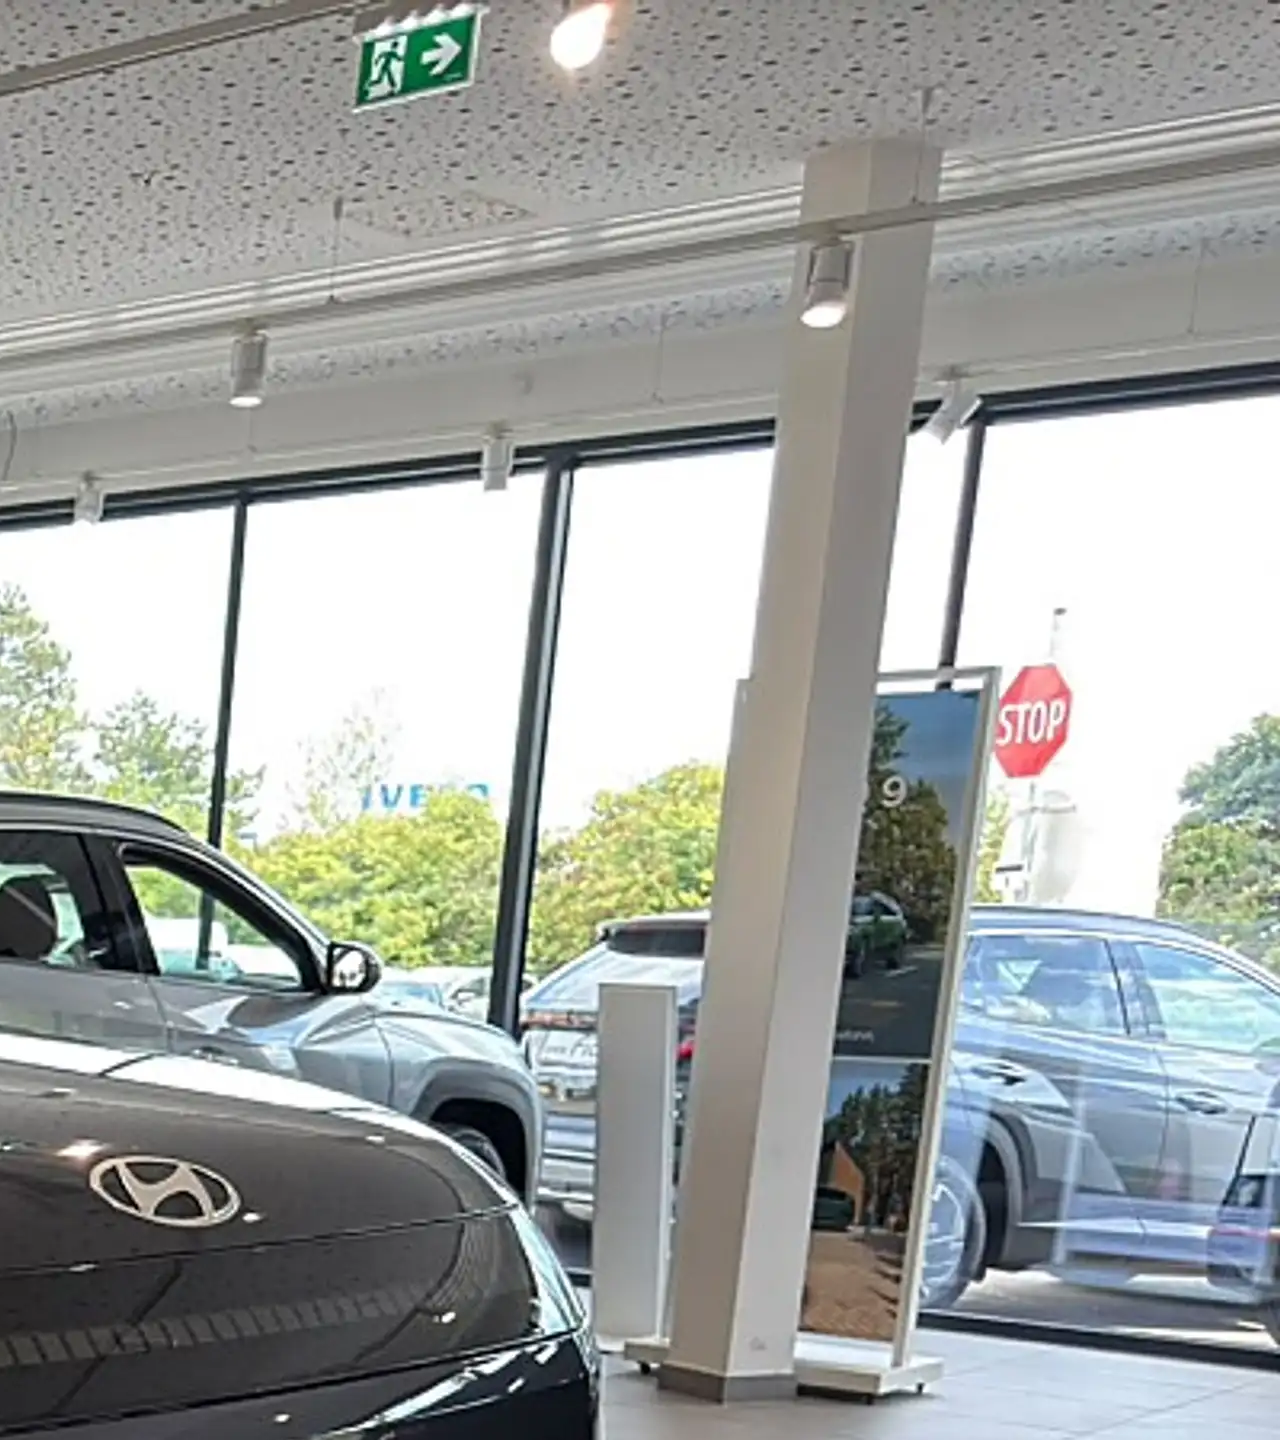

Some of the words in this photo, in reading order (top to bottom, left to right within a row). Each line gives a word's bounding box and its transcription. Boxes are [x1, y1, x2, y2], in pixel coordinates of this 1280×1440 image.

[996, 699, 1066, 747] STOP
[360, 783, 490, 812] IVE
[881, 775, 907, 808] 9
